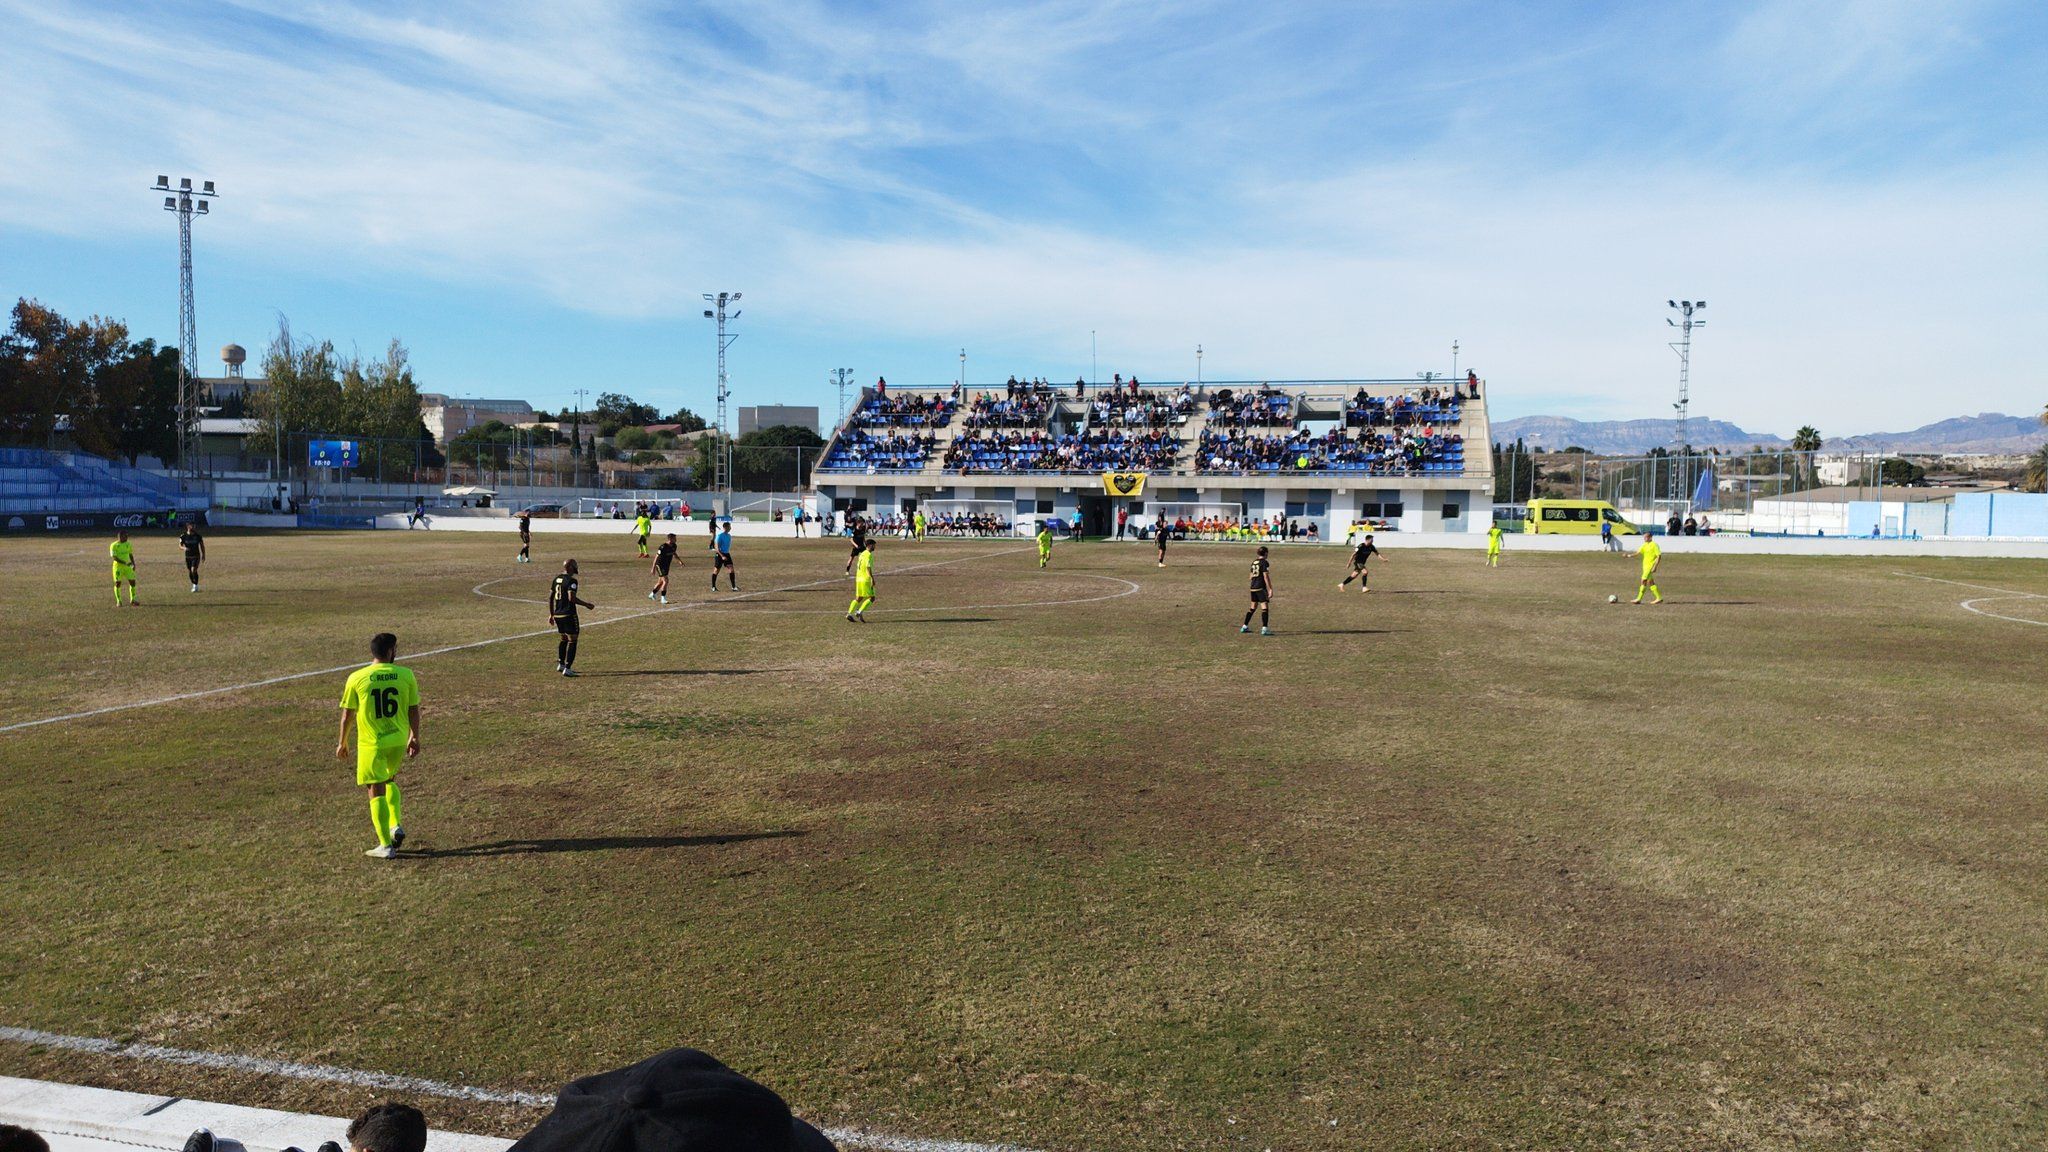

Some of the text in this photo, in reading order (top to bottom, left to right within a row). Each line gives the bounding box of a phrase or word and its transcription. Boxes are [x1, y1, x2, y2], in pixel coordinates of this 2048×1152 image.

[319, 450, 349, 459] 0 0
[370, 686, 399, 719] 16
